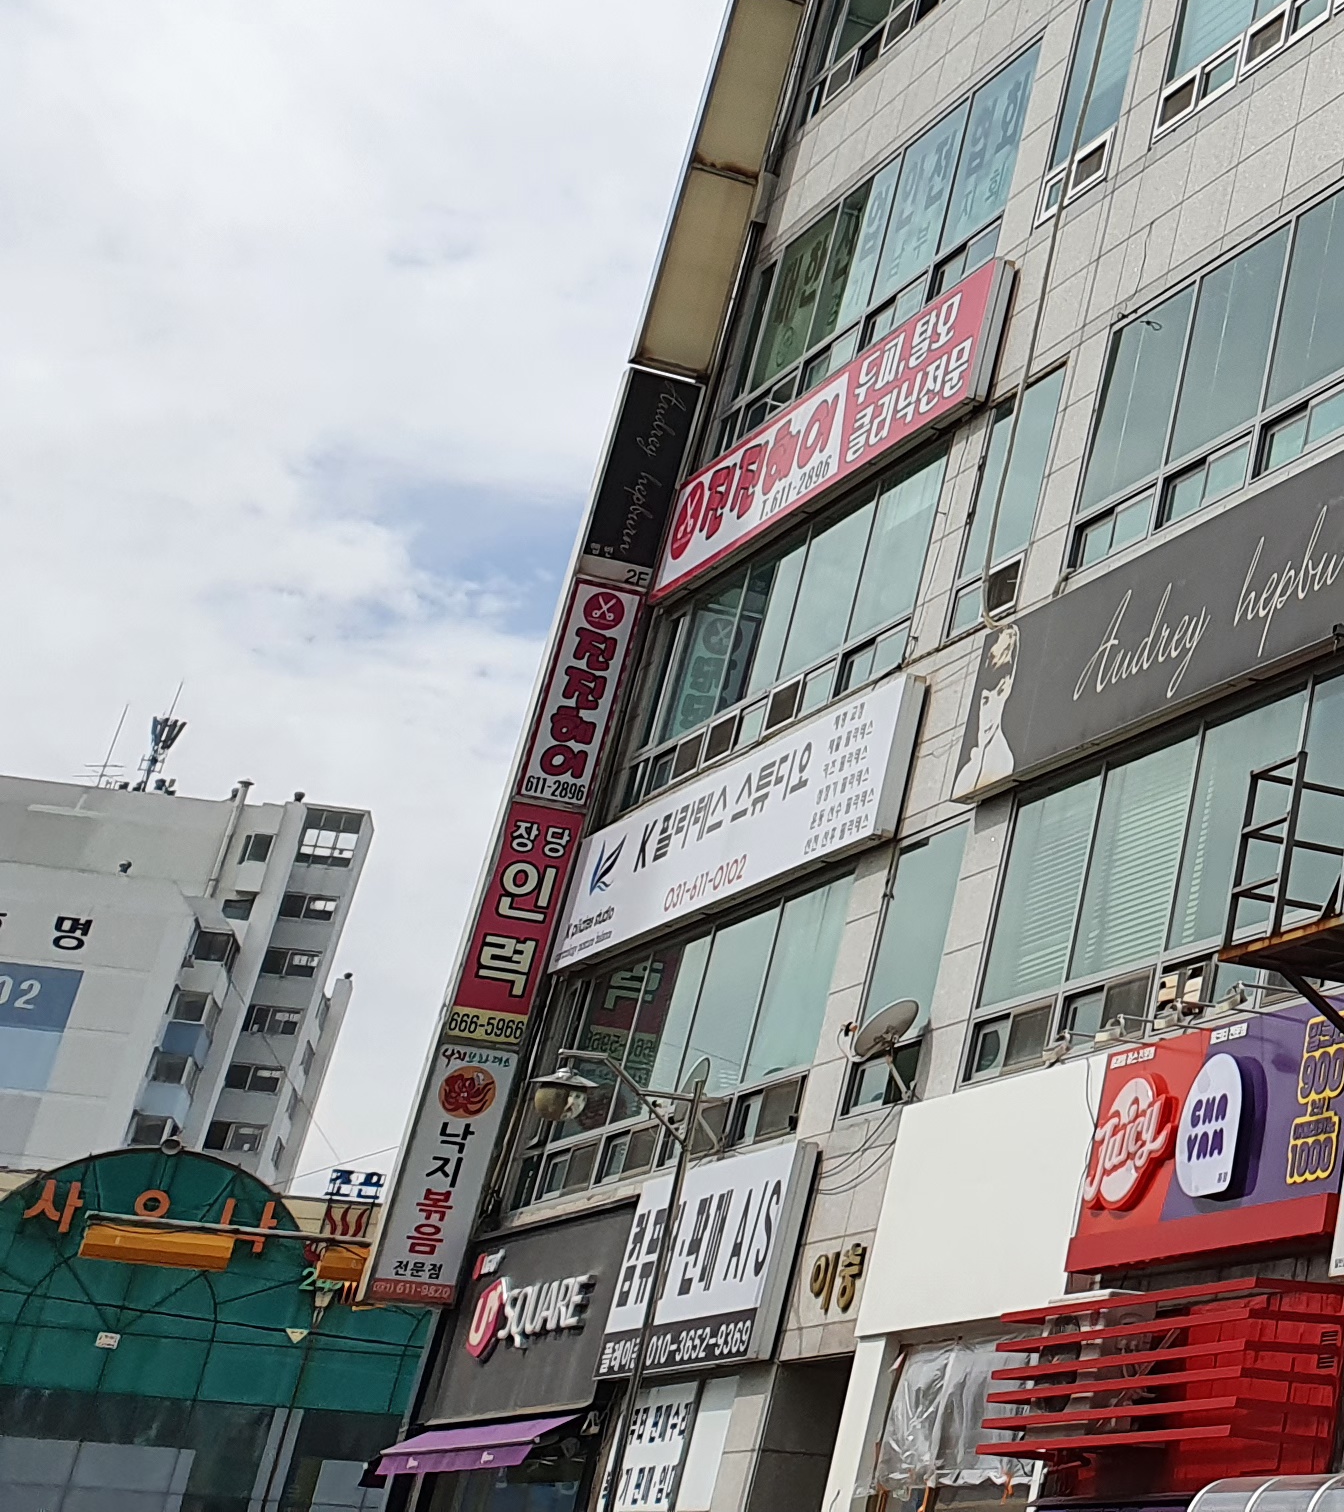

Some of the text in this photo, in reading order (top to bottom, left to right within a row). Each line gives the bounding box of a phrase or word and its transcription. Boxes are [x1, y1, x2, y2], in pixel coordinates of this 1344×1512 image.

[759, 454, 833, 521] T.611-2896
[623, 568, 651, 585] 2F
[1072, 588, 1212, 701] Audrey
[524, 774, 587, 803] 611-2896
[633, 741, 813, 873] K 필라테스 스튜디오
[509, 819, 571, 858] 장당
[663, 853, 748, 913] 031-611-0102
[475, 860, 558, 1000] 인력
[449, 1011, 525, 1041] 666-5966
[1288, 1135, 1335, 1180] 1000
[406, 1120, 475, 1257] 낙지볶음
[722, 1178, 783, 1284] A/S
[392, 1259, 444, 1281] 전문점
[497, 1273, 590, 1349] SQUARE
[645, 1319, 754, 1368] 010-3652-9369
